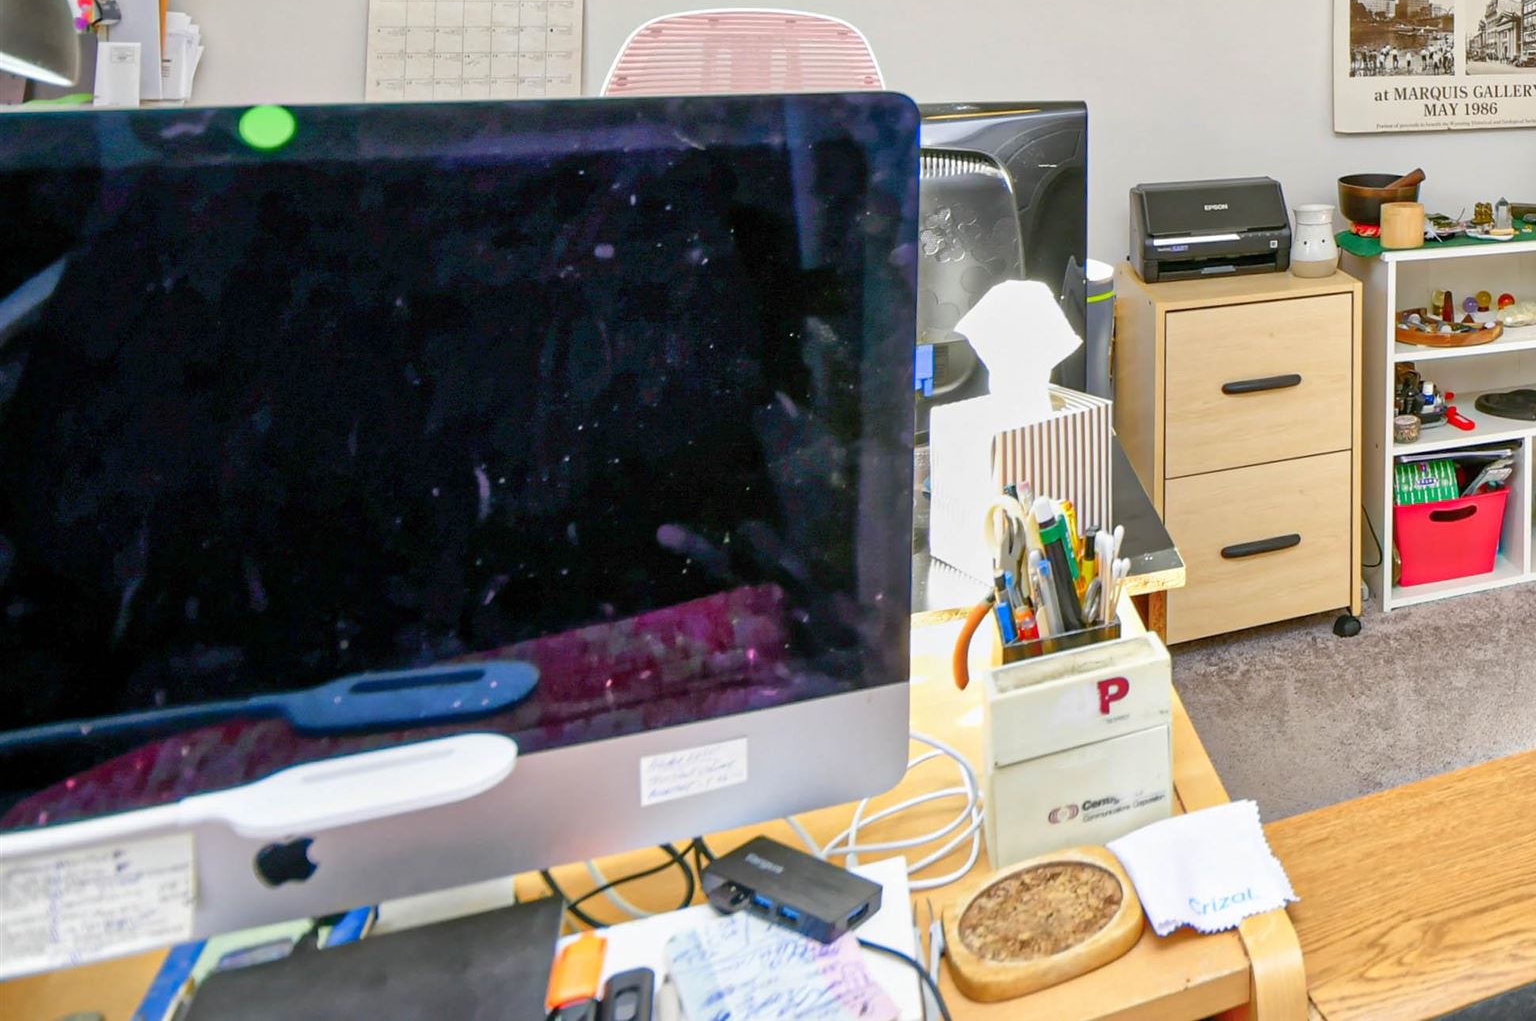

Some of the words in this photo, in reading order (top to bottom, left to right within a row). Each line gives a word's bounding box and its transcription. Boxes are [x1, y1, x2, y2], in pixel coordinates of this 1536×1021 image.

[1374, 88, 1389, 102] at
[1394, 85, 1468, 101] MARQUIS
[1424, 103, 1458, 117] MAY
[1464, 102, 1498, 116] 1986
[1097, 677, 1129, 714] P
